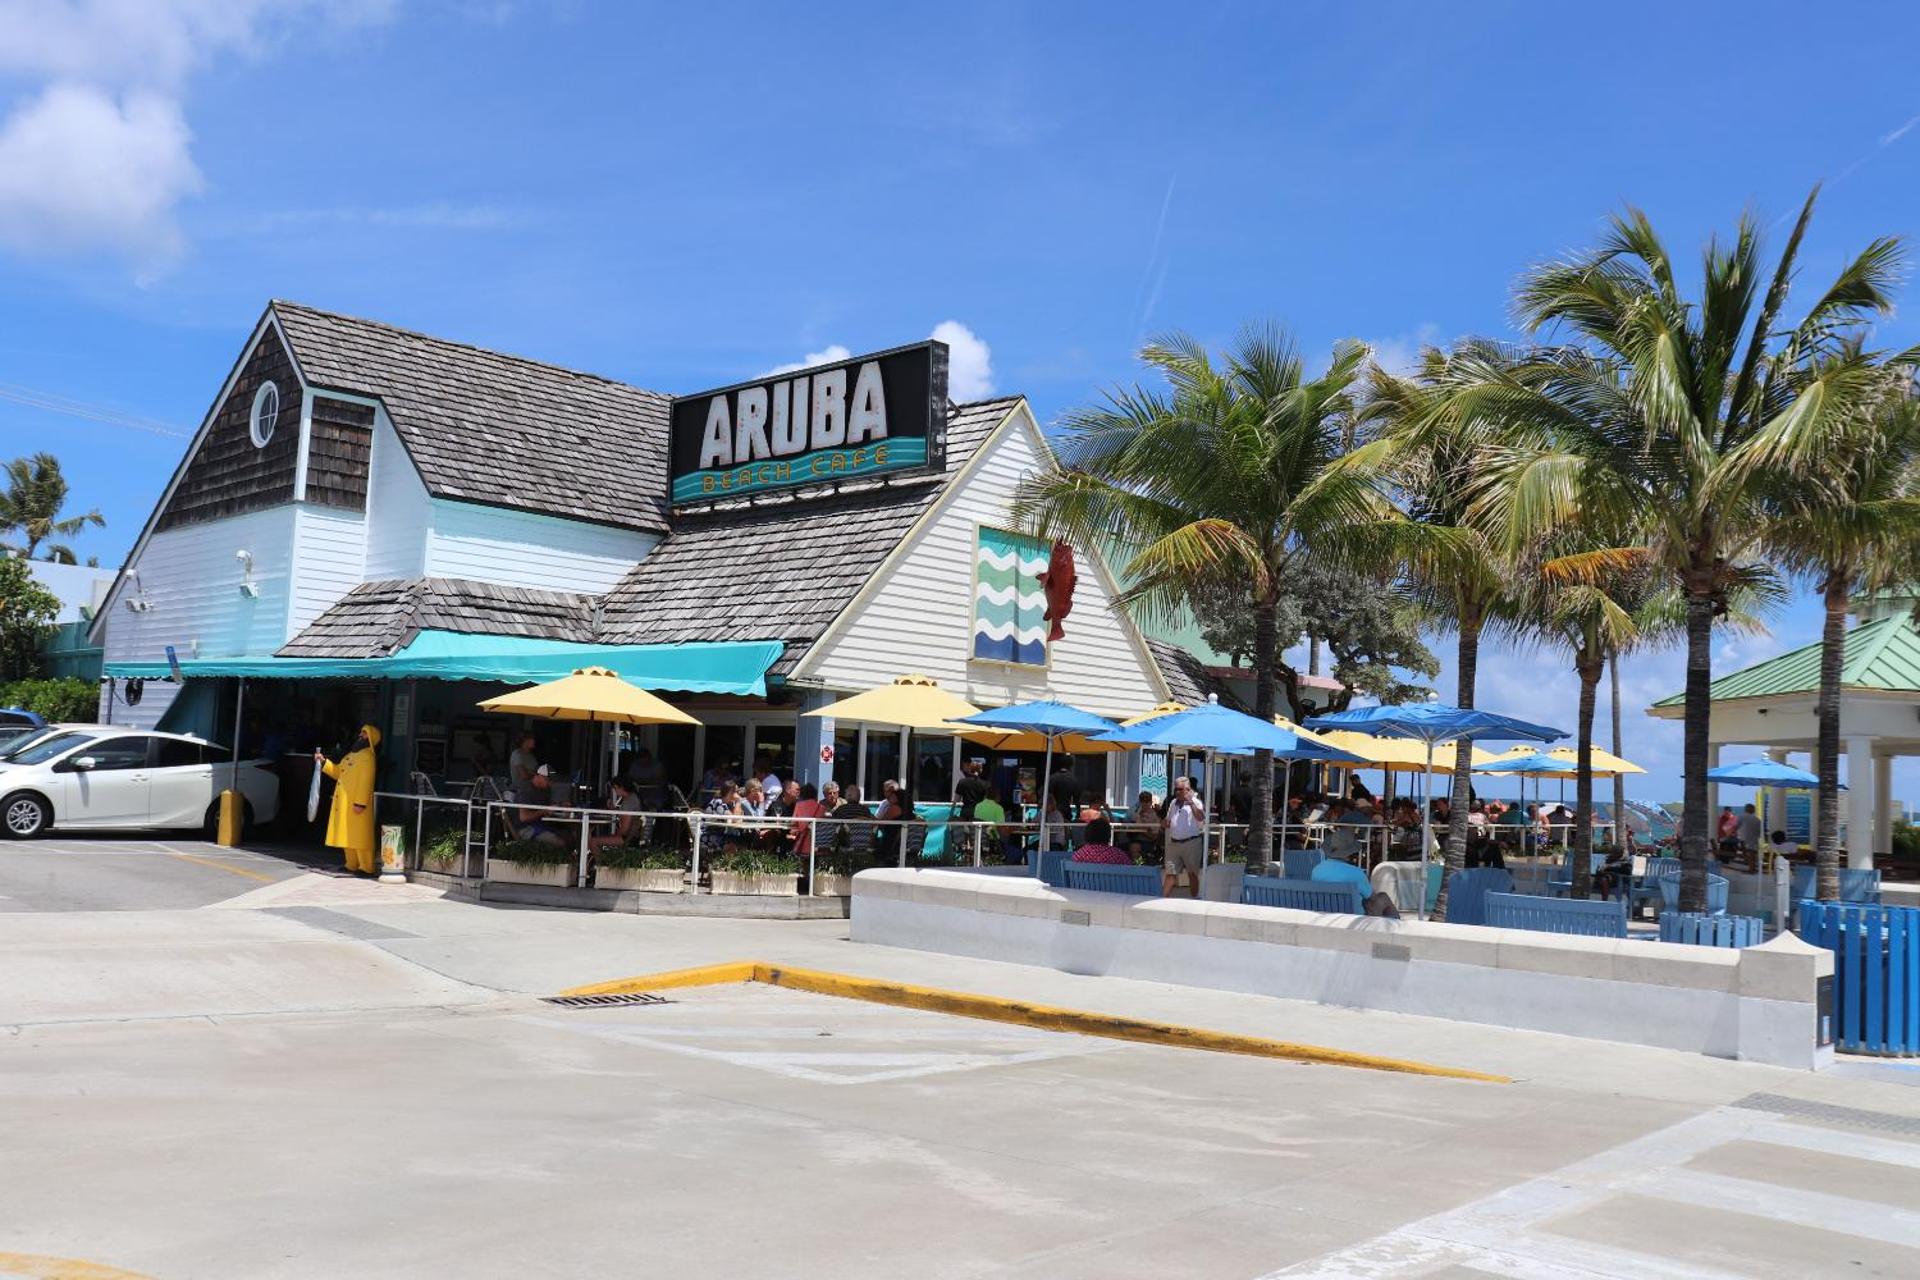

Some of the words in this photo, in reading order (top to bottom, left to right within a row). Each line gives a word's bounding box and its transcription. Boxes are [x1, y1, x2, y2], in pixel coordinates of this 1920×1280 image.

[701, 361, 887, 468] ARUBA
[703, 462, 791, 492] BEACH
[812, 445, 888, 475] CAFE
[1142, 753, 1167, 777] ARUBA
